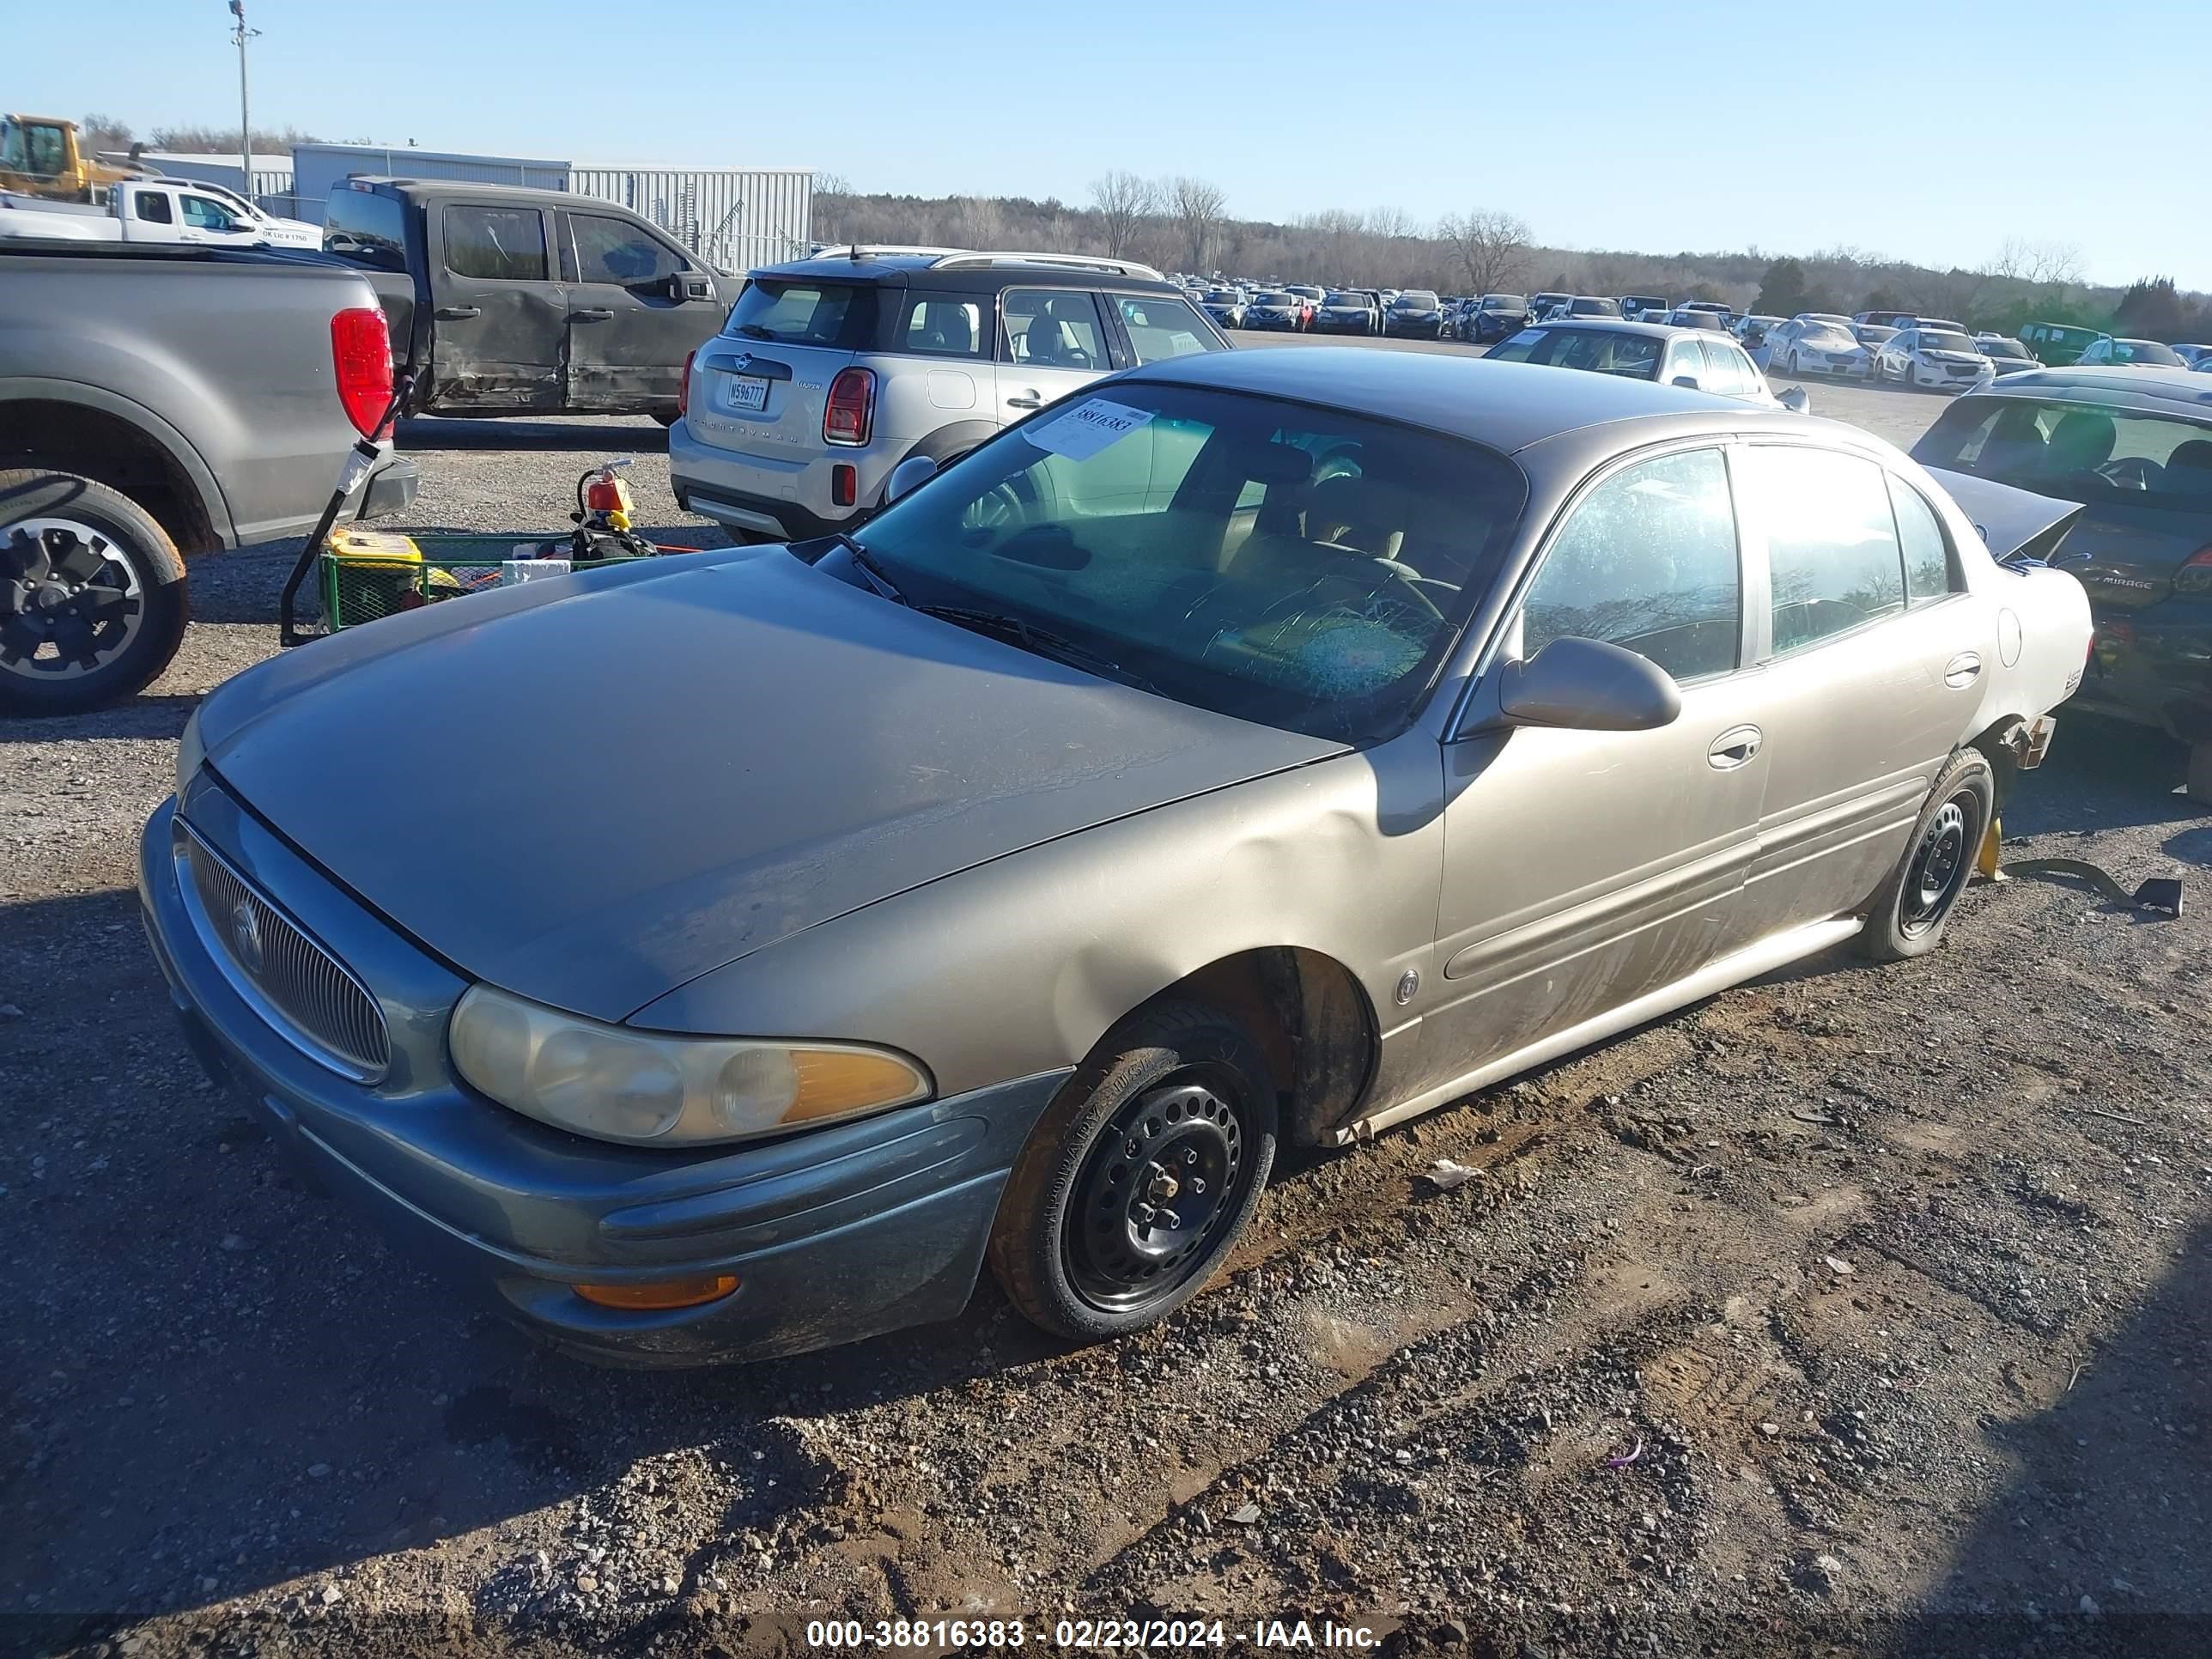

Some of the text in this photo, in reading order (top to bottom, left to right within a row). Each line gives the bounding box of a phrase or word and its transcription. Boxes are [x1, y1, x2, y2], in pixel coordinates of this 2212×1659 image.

[731, 383, 764, 402] N596777
[1072, 409, 1132, 430] 38816383
[2103, 577, 2152, 590] MIRAGE
